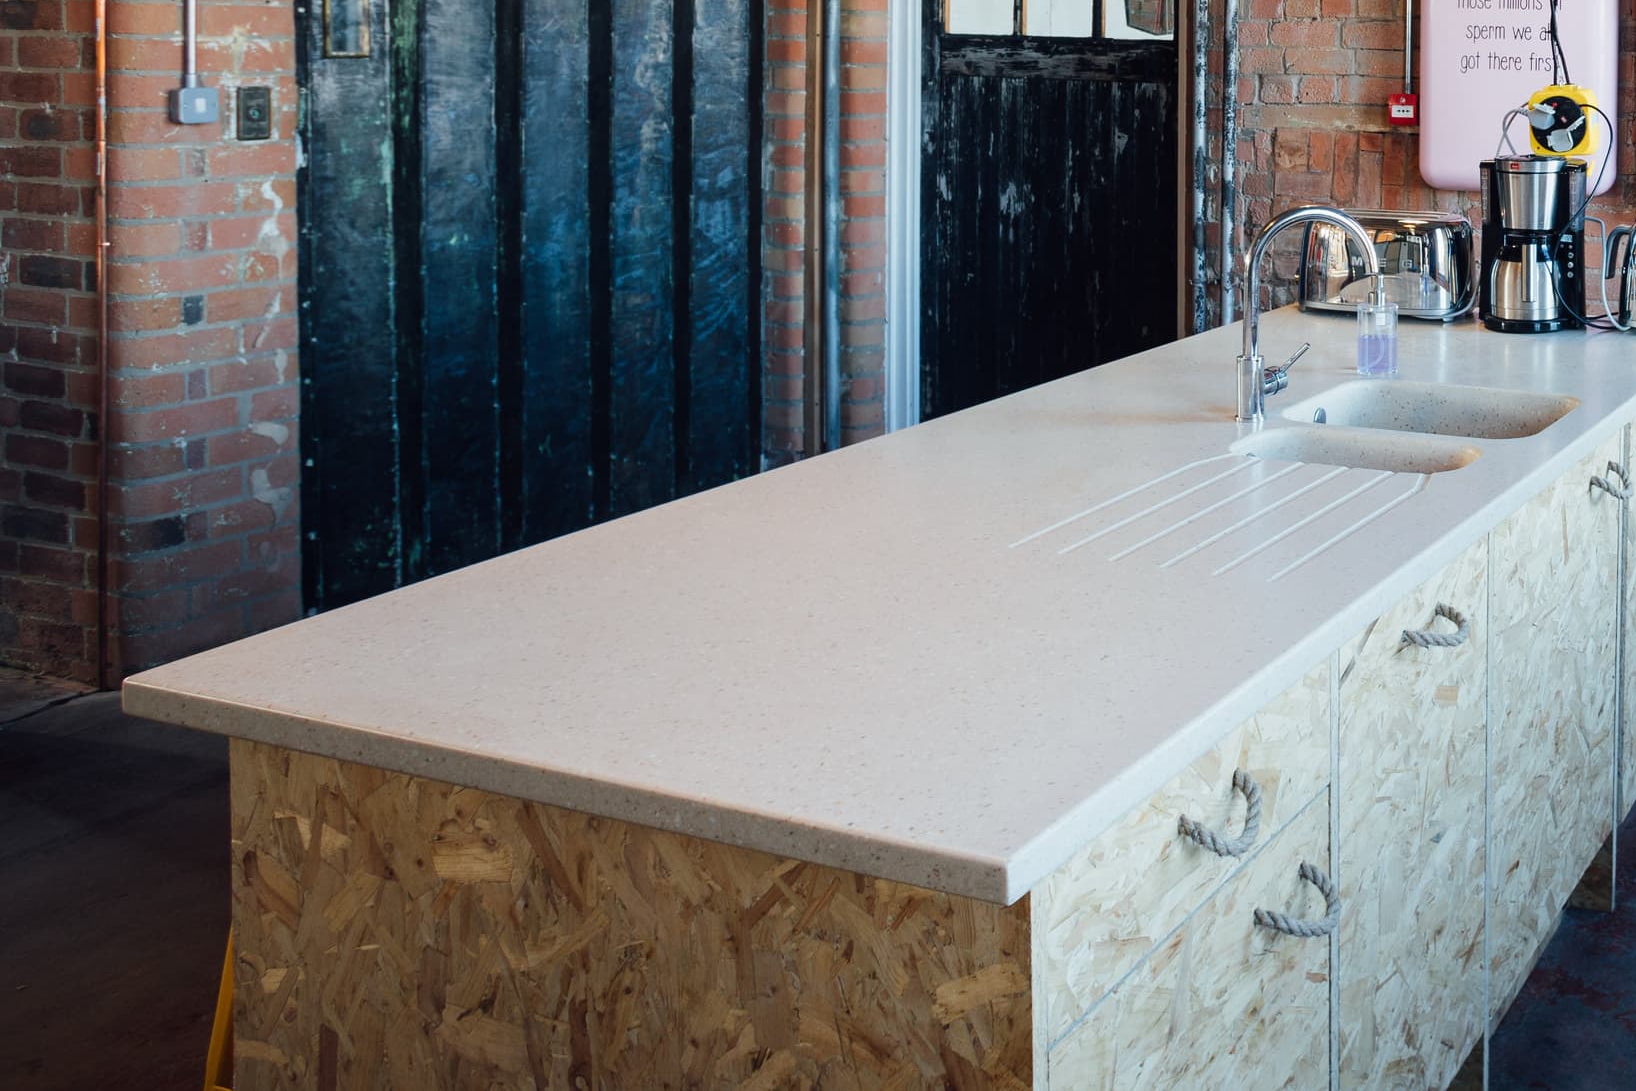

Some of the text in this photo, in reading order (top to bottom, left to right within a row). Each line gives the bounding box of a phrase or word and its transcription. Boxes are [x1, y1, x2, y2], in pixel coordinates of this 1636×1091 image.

[1466, 23, 1554, 44] sperm we al
[1460, 51, 1556, 74] got there firs
